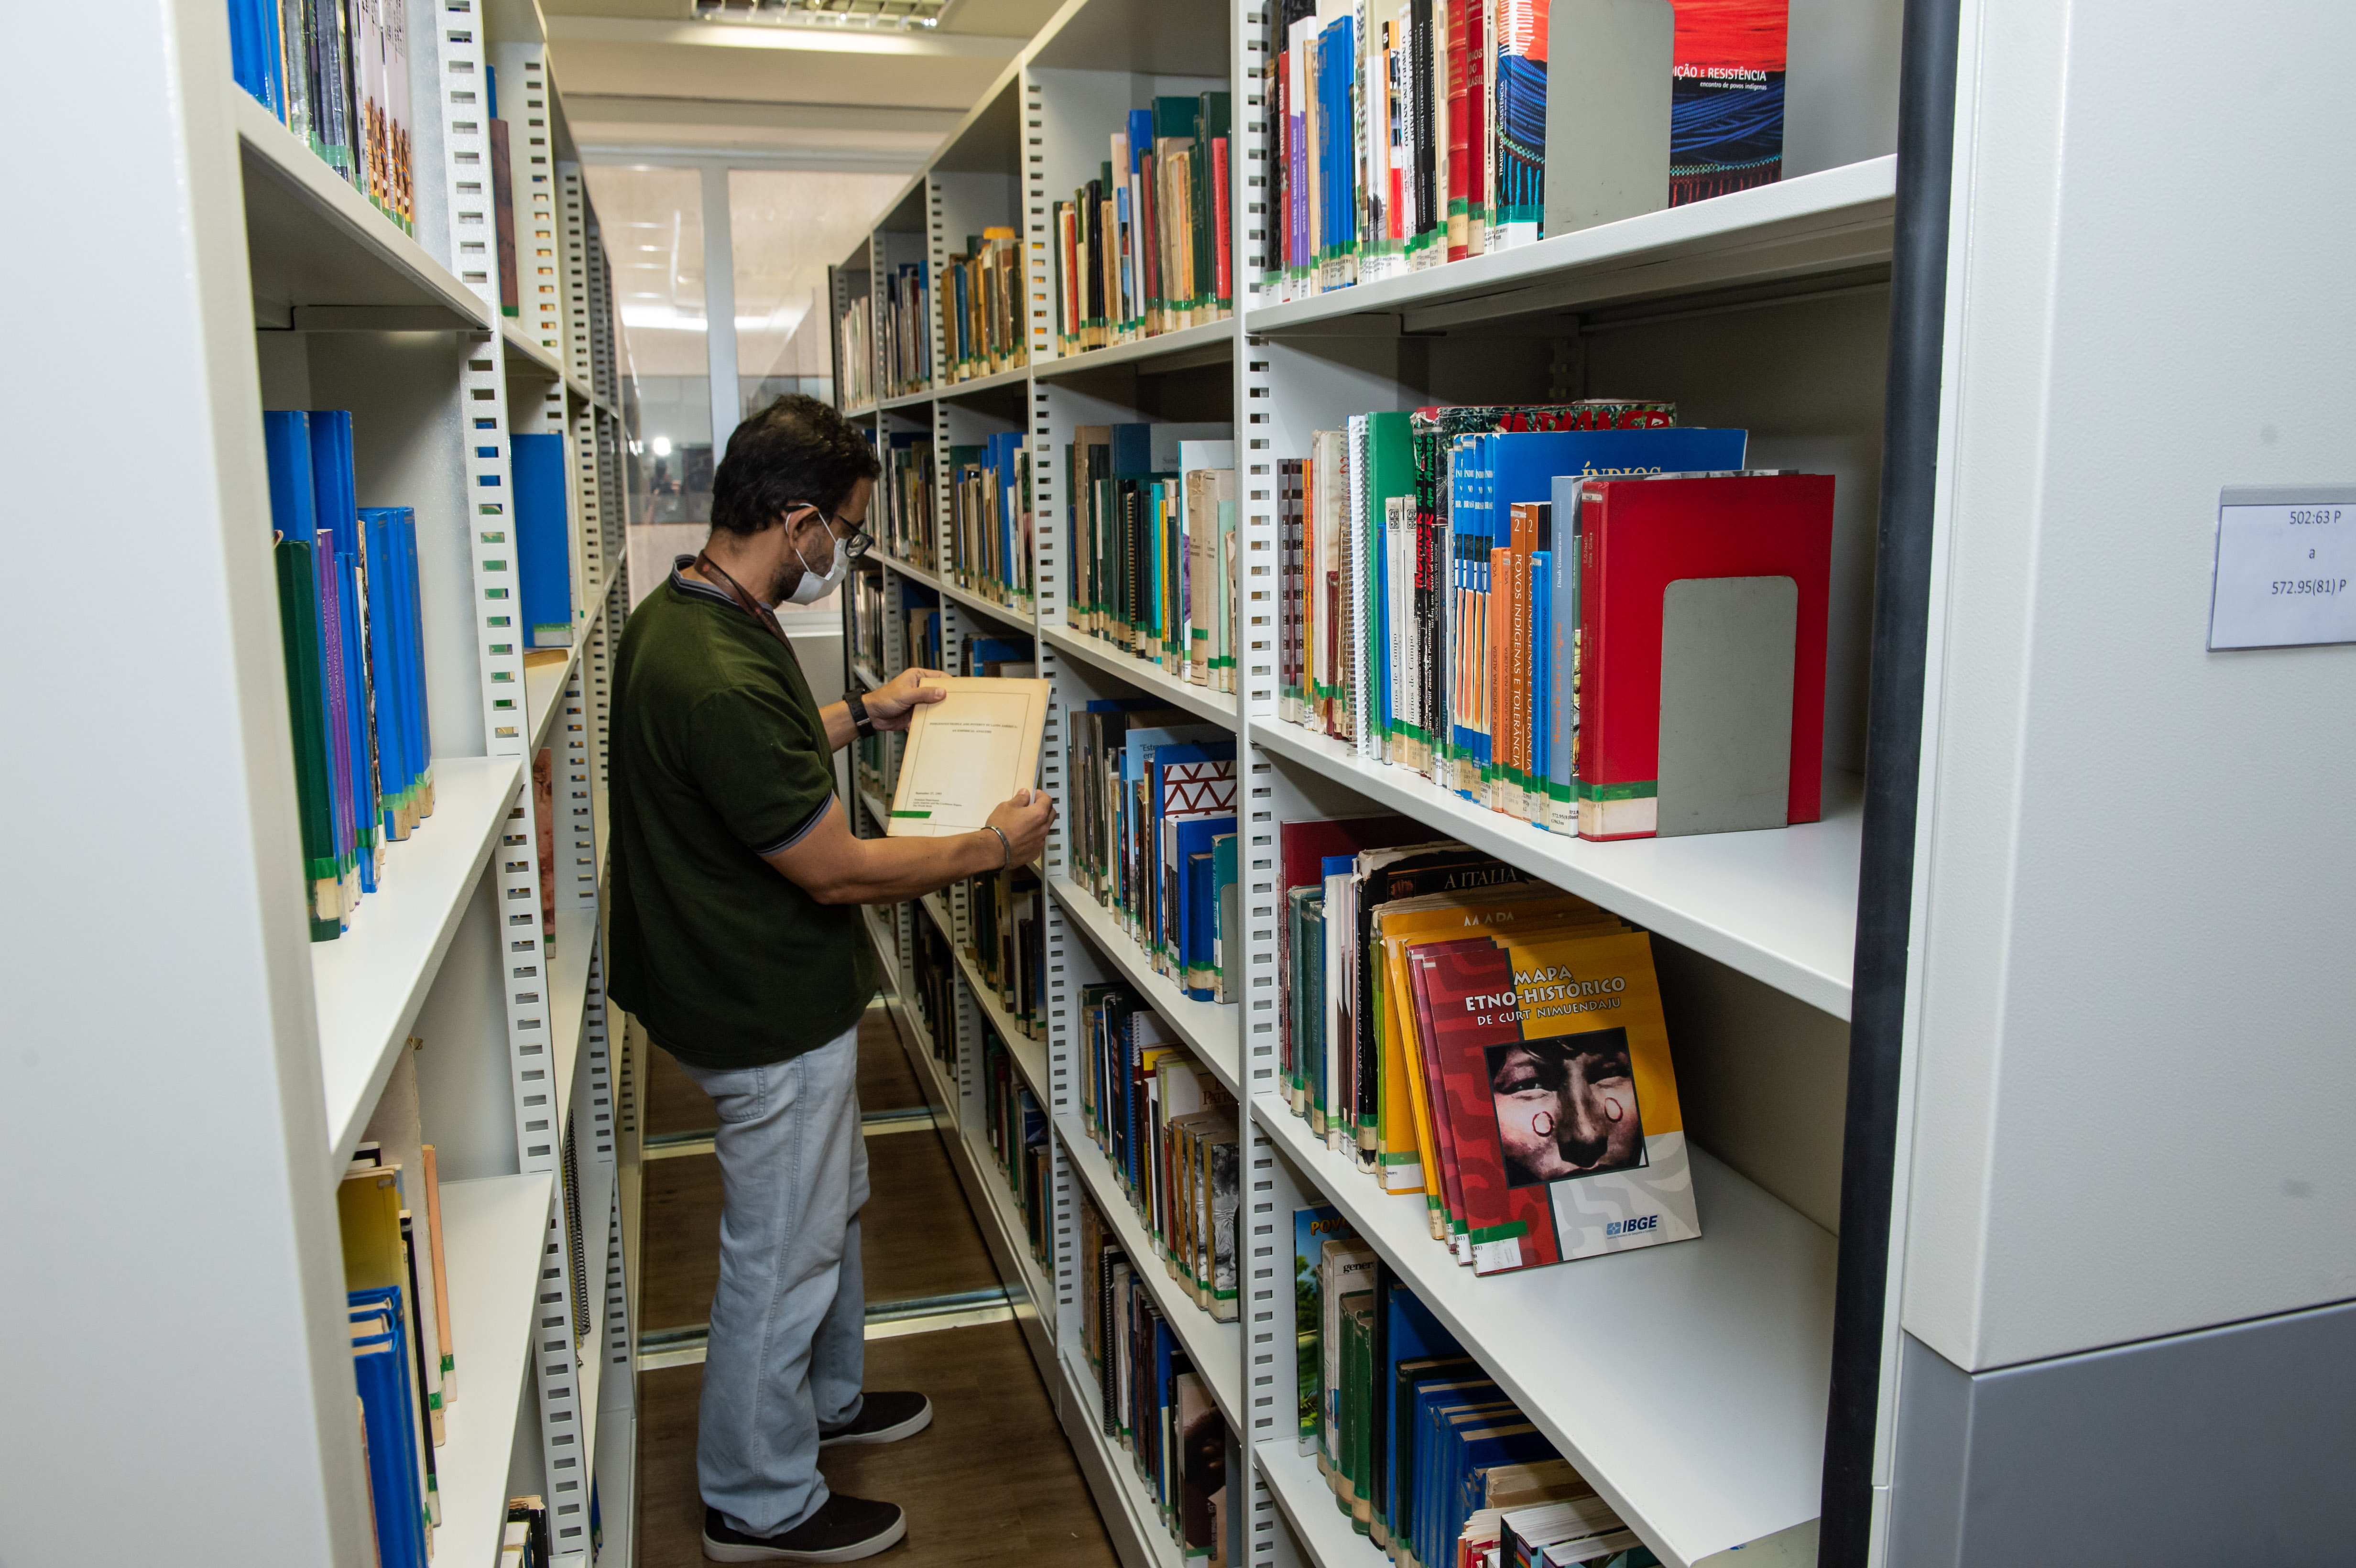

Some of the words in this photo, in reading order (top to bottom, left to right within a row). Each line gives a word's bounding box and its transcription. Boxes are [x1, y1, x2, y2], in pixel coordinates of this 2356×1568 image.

[1383, 33, 1389, 44] 5
[1469, 64, 1477, 75] DO
[1673, 63, 1697, 80] IÇÃO
[1701, 69, 1705, 77] E
[1708, 66, 1767, 81] RESISTÊNCIA
[1468, 75, 1483, 88] RASIL
[1745, 83, 1767, 91] indígenas
[2290, 510, 2330, 524] 502:63
[2334, 510, 2341, 523] P
[1515, 519, 1520, 532] 2
[1528, 519, 1533, 532] 2
[2309, 549, 2315, 559] a
[2272, 578, 2335, 596] 572.95(81)
[2339, 579, 2346, 592] P
[1514, 604, 1523, 674] INDÍGENAS
[1555, 622, 1563, 661] origens
[1393, 673, 1398, 685] de
[1408, 675, 1414, 687] de
[1493, 675, 1497, 685] NA
[1554, 695, 1560, 708] de
[1513, 689, 1522, 766] TOLERÂNCIA
[1444, 873, 1456, 889] A
[1461, 868, 1517, 887] ITALIA
[1514, 965, 1572, 986] MAPA
[1465, 977, 1626, 1012] ETNO-HISTÓRICO
[1476, 1014, 1493, 1026] DE
[1499, 1010, 1531, 1023] CURT
[1537, 997, 1621, 1018] NIMUENDAJU
[1623, 1215, 1658, 1233] IBGE
